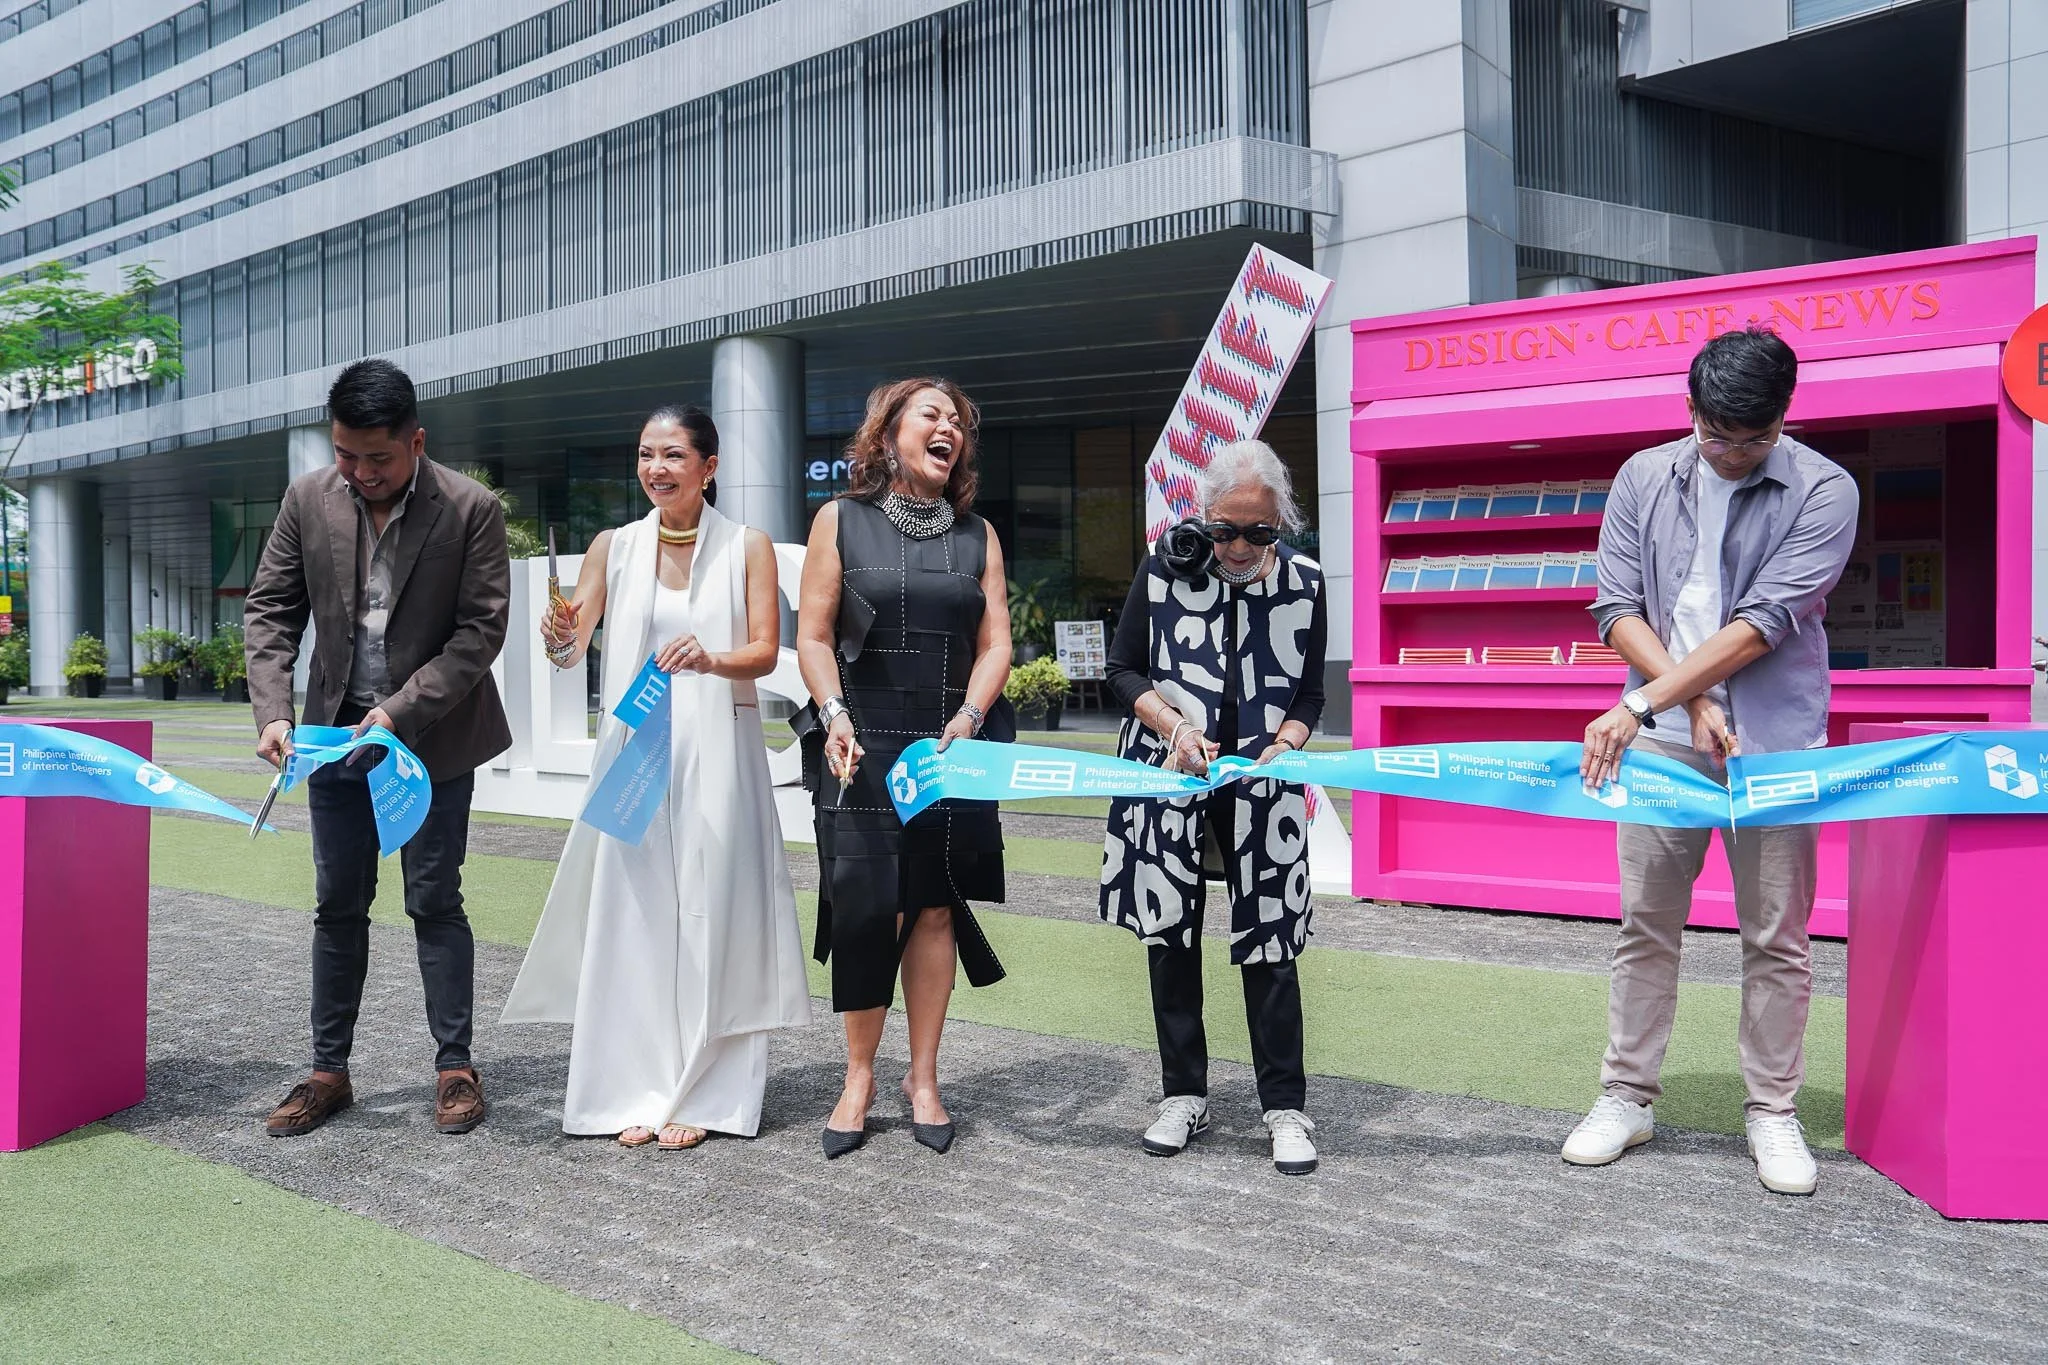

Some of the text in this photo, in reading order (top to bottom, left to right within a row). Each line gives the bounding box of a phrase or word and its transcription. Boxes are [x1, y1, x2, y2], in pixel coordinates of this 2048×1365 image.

[1404, 280, 1941, 372] DESIGN CAFE NEWS
[22, 748, 108, 763] Philippine Institute
[1448, 752, 1551, 773] Philippine Institute
[21, 761, 112, 776] of Interior Designers
[917, 764, 986, 780] Interior Design
[1085, 767, 1139, 778] Philippine
[1449, 765, 1557, 787] of Interior Designers
[1631, 769, 1670, 783] Manila
[1828, 761, 1947, 781] Philippine Institute
[918, 775, 945, 793] Summit
[1082, 779, 1094, 788] of
[1097, 779, 1139, 789] Interior
[1632, 782, 1719, 801] Interior Design
[1829, 775, 1960, 793] of Interior Designers
[378, 784, 409, 815] Interior
[389, 792, 417, 823] Manila
[1632, 796, 1678, 808] Summit
